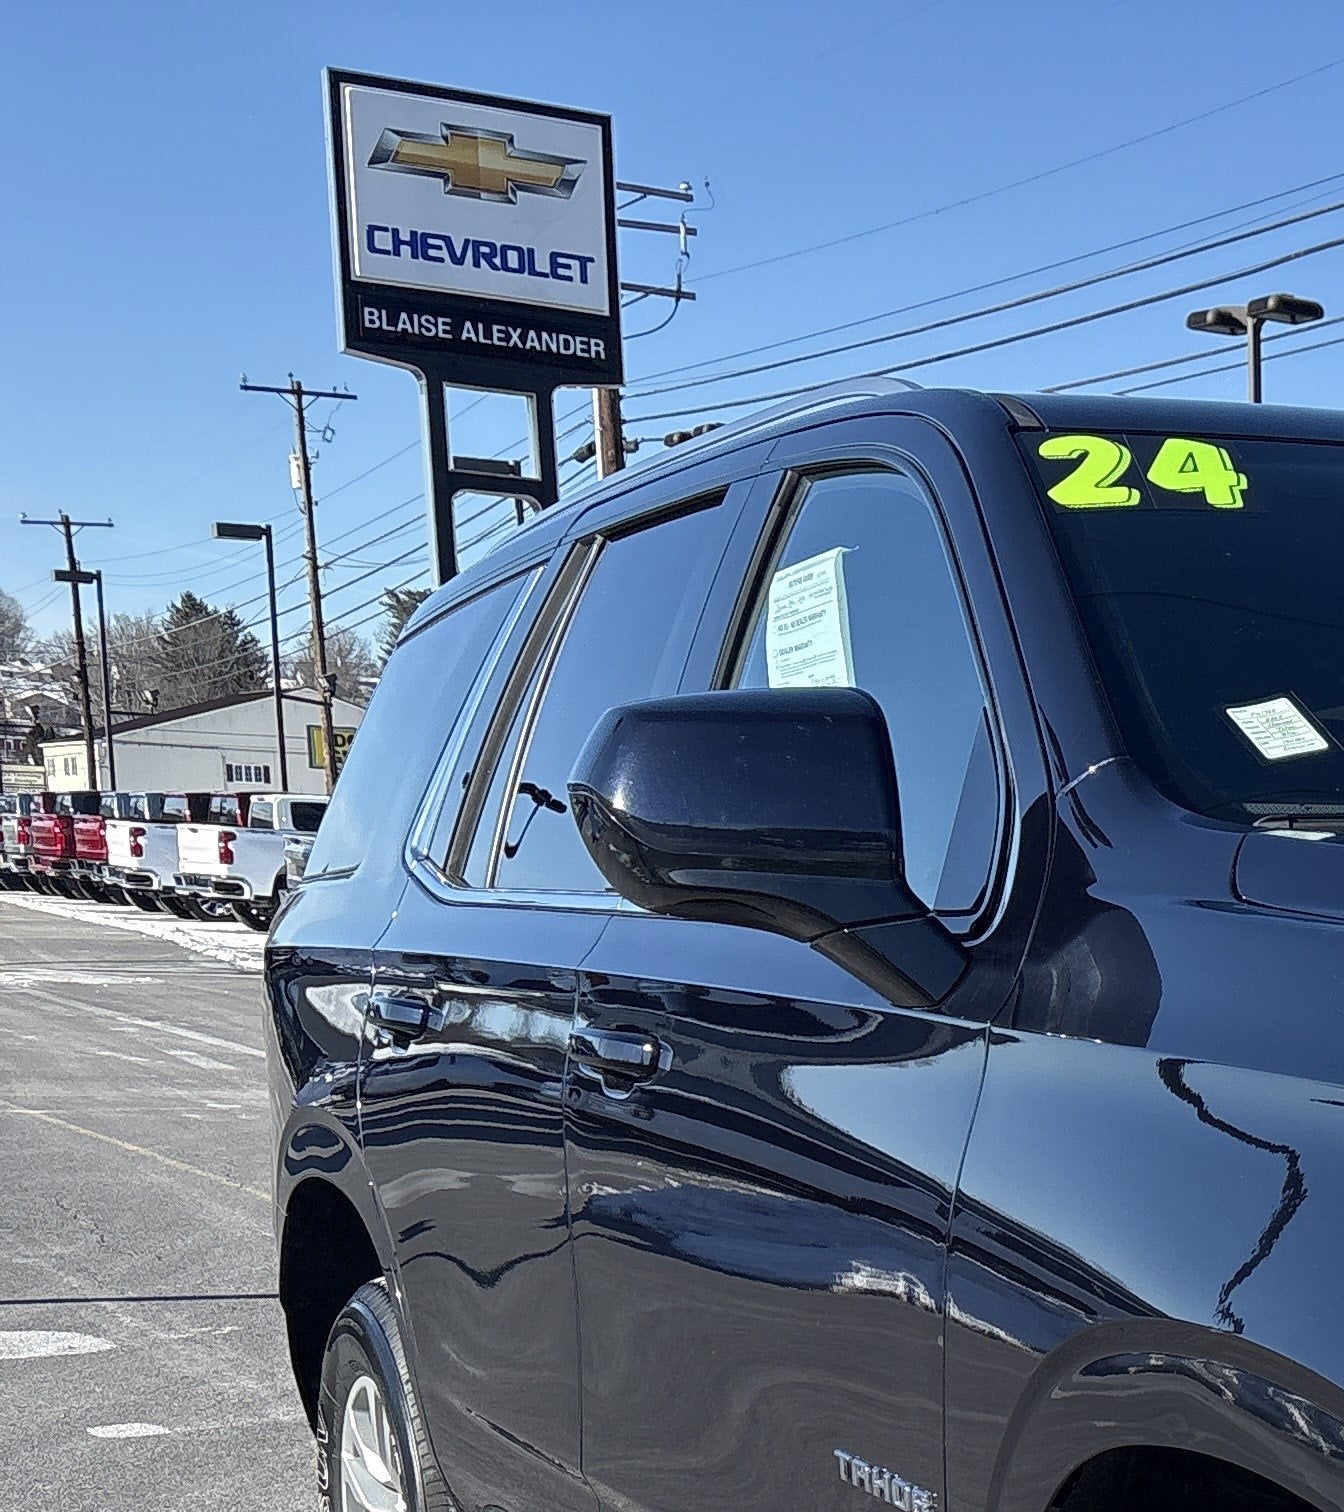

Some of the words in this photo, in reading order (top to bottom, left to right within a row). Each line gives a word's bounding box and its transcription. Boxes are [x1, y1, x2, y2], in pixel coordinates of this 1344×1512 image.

[366, 223, 595, 285] CHEVROLET
[362, 306, 453, 340] BLAISE
[460, 319, 606, 361] ALEXANDER
[1038, 435, 1248, 509] 24
